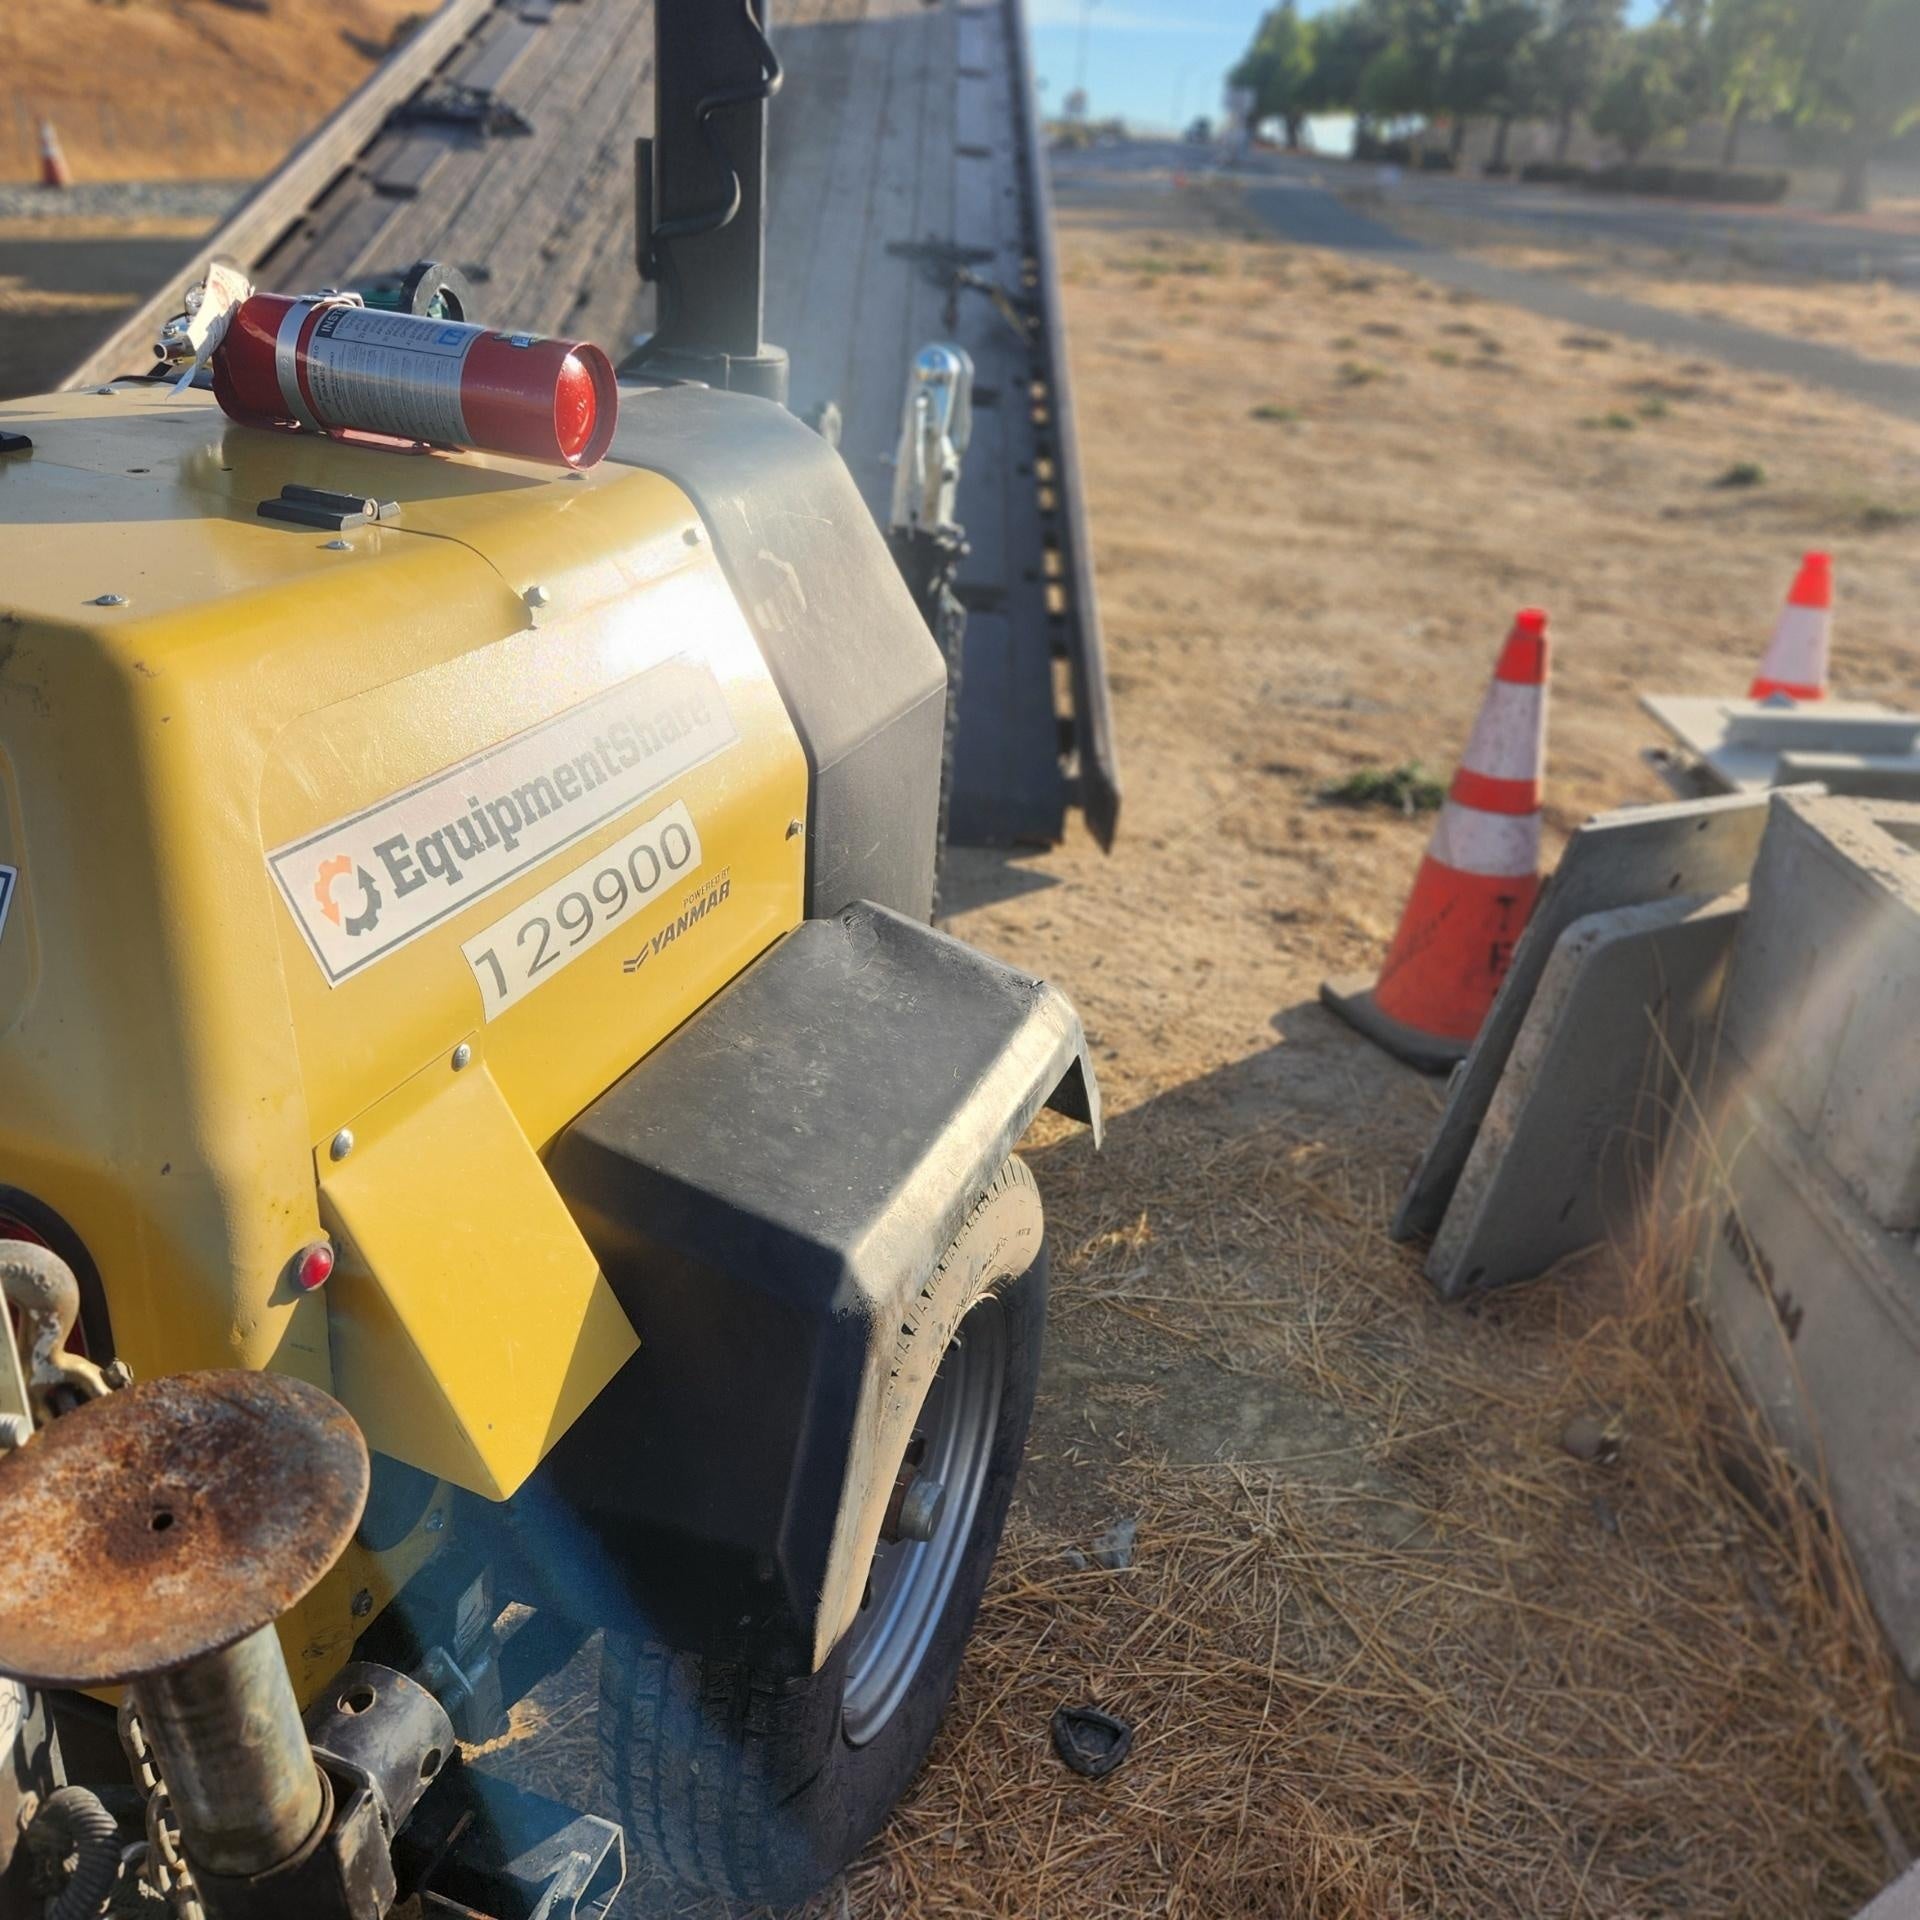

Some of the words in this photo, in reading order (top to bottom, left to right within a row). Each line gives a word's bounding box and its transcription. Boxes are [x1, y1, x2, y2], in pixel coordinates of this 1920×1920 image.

[373, 692, 711, 899] EquipmentShare
[475, 823, 692, 999] 129900
[651, 879, 731, 956] YANMAR
[683, 871, 721, 909] POWERED
